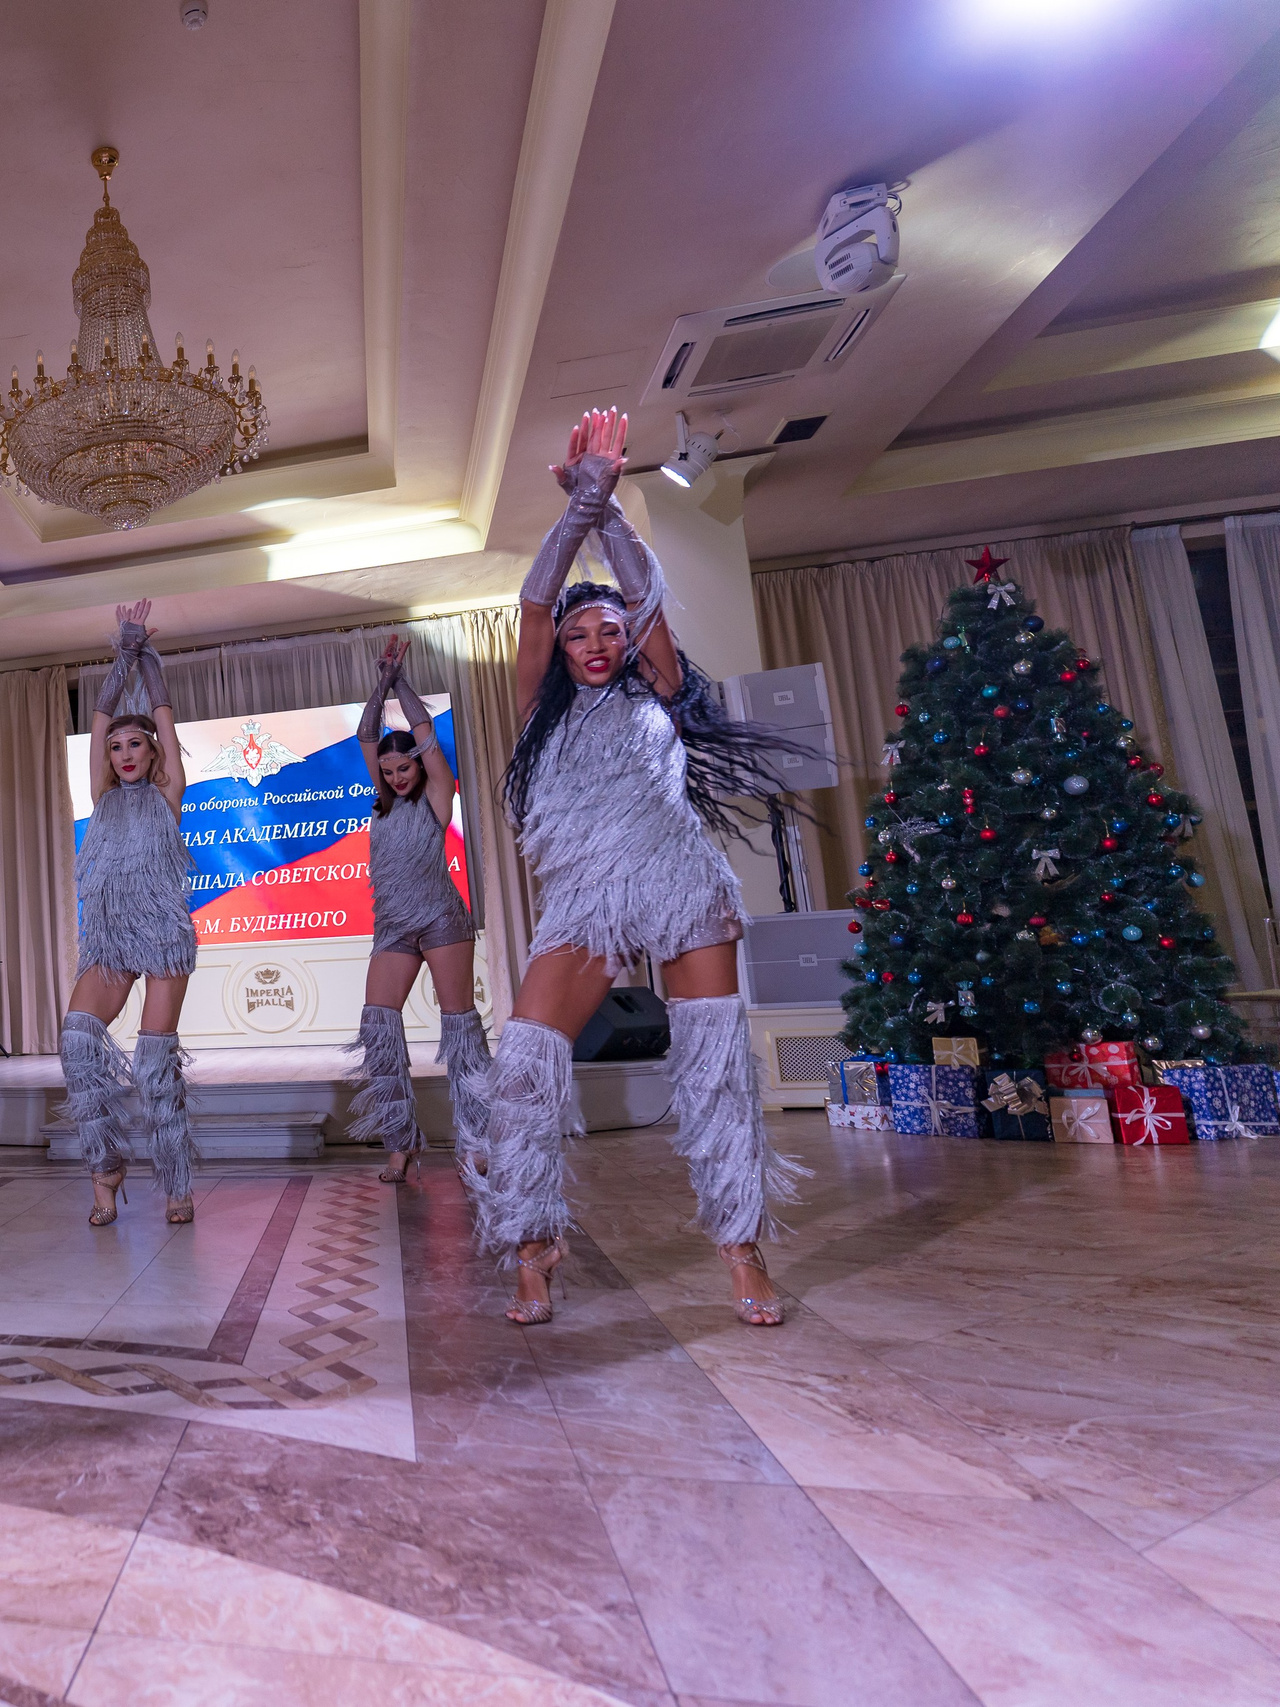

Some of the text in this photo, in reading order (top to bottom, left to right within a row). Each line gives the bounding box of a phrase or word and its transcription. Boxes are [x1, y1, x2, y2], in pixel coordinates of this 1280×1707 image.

[181, 802, 196, 813] во
[199, 796, 259, 812] обороны
[262, 785, 344, 806] Российской
[180, 816, 372, 847] НАЯ АКАДЕМИЯ СВЯ
[228, 910, 347, 934] БУДЕННОГО
[245, 985, 294, 998] IMPERIA
